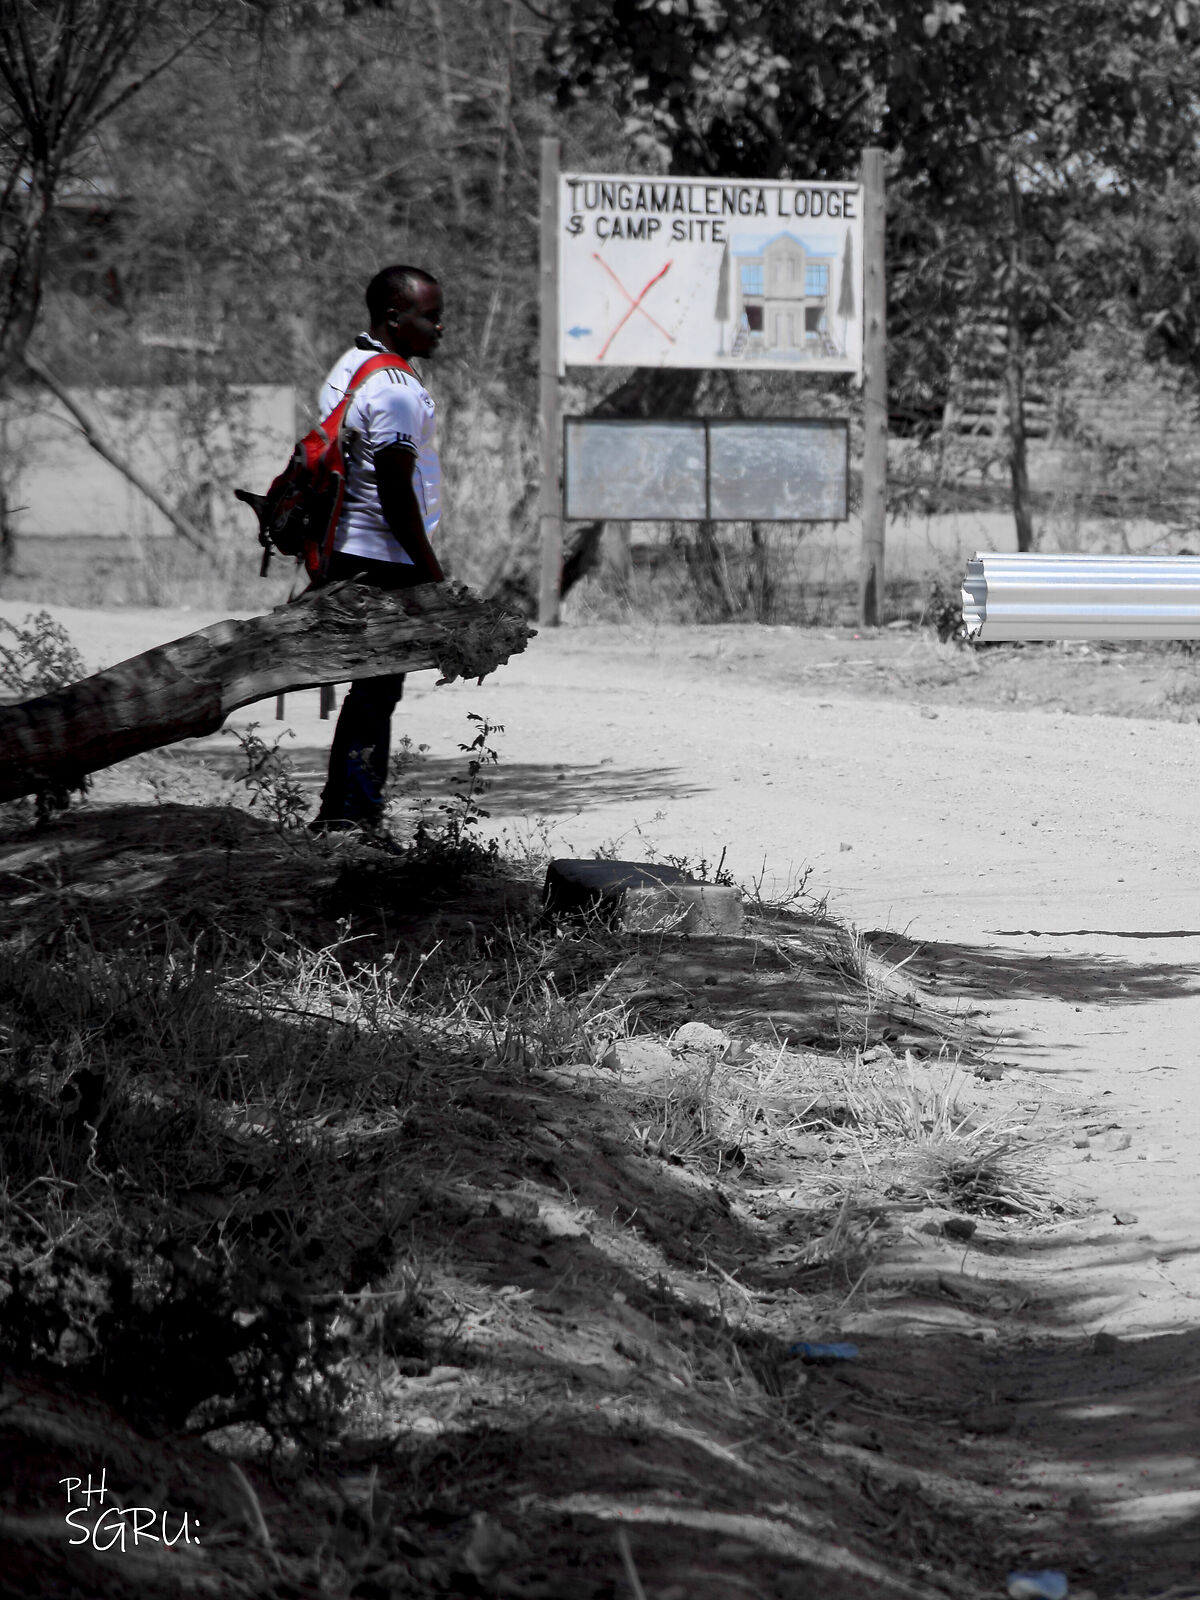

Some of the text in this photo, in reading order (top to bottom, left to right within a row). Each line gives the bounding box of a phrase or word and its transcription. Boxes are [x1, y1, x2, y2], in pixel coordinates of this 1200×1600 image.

[567, 181, 858, 218] TUNGAMALENGA LODGE
[595, 215, 662, 241] CAMP
[671, 218, 727, 244] SITE
